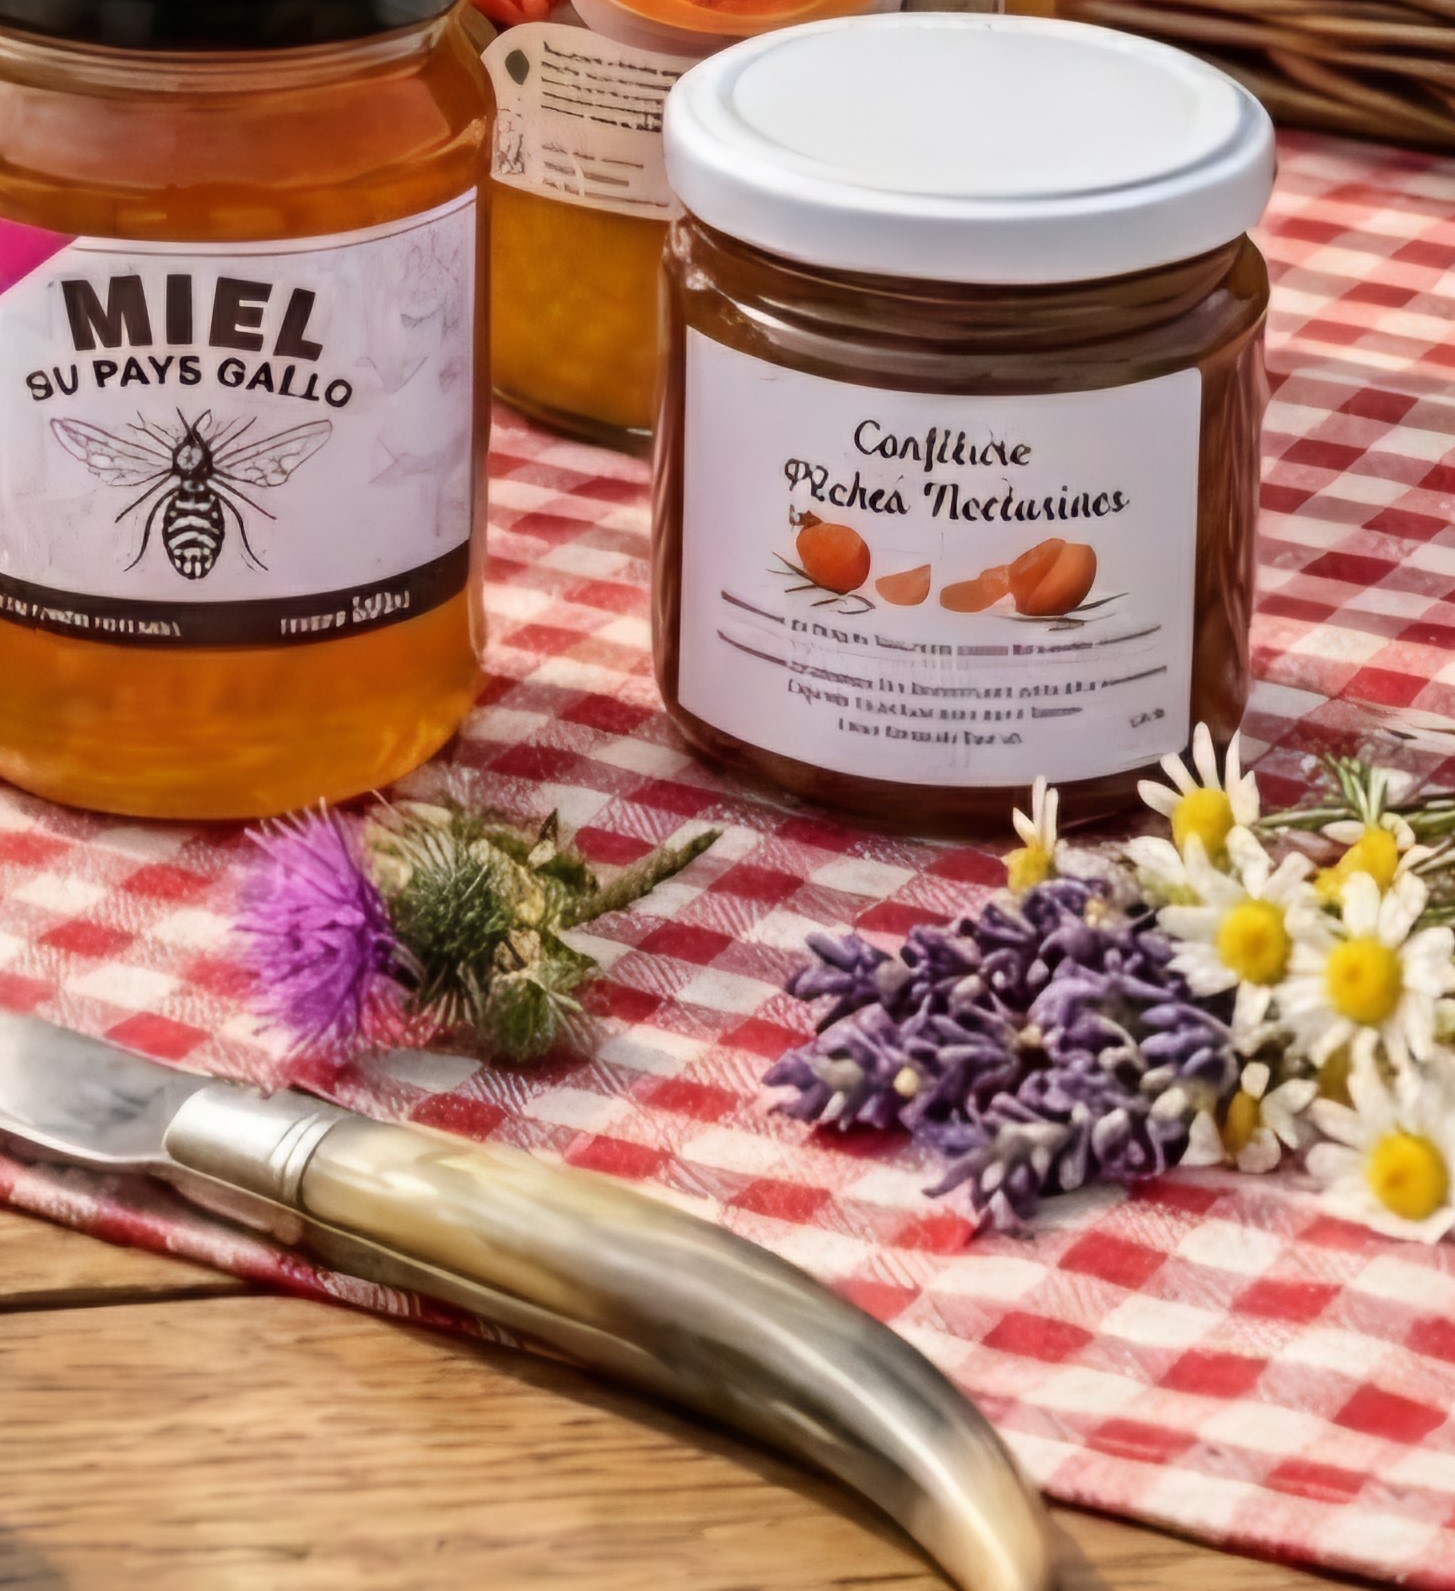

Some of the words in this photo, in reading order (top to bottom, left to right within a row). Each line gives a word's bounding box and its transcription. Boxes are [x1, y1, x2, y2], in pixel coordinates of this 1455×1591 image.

[61, 274, 323, 361] MIEL
[93, 356, 202, 387] PAYS
[217, 357, 353, 407] GALLO
